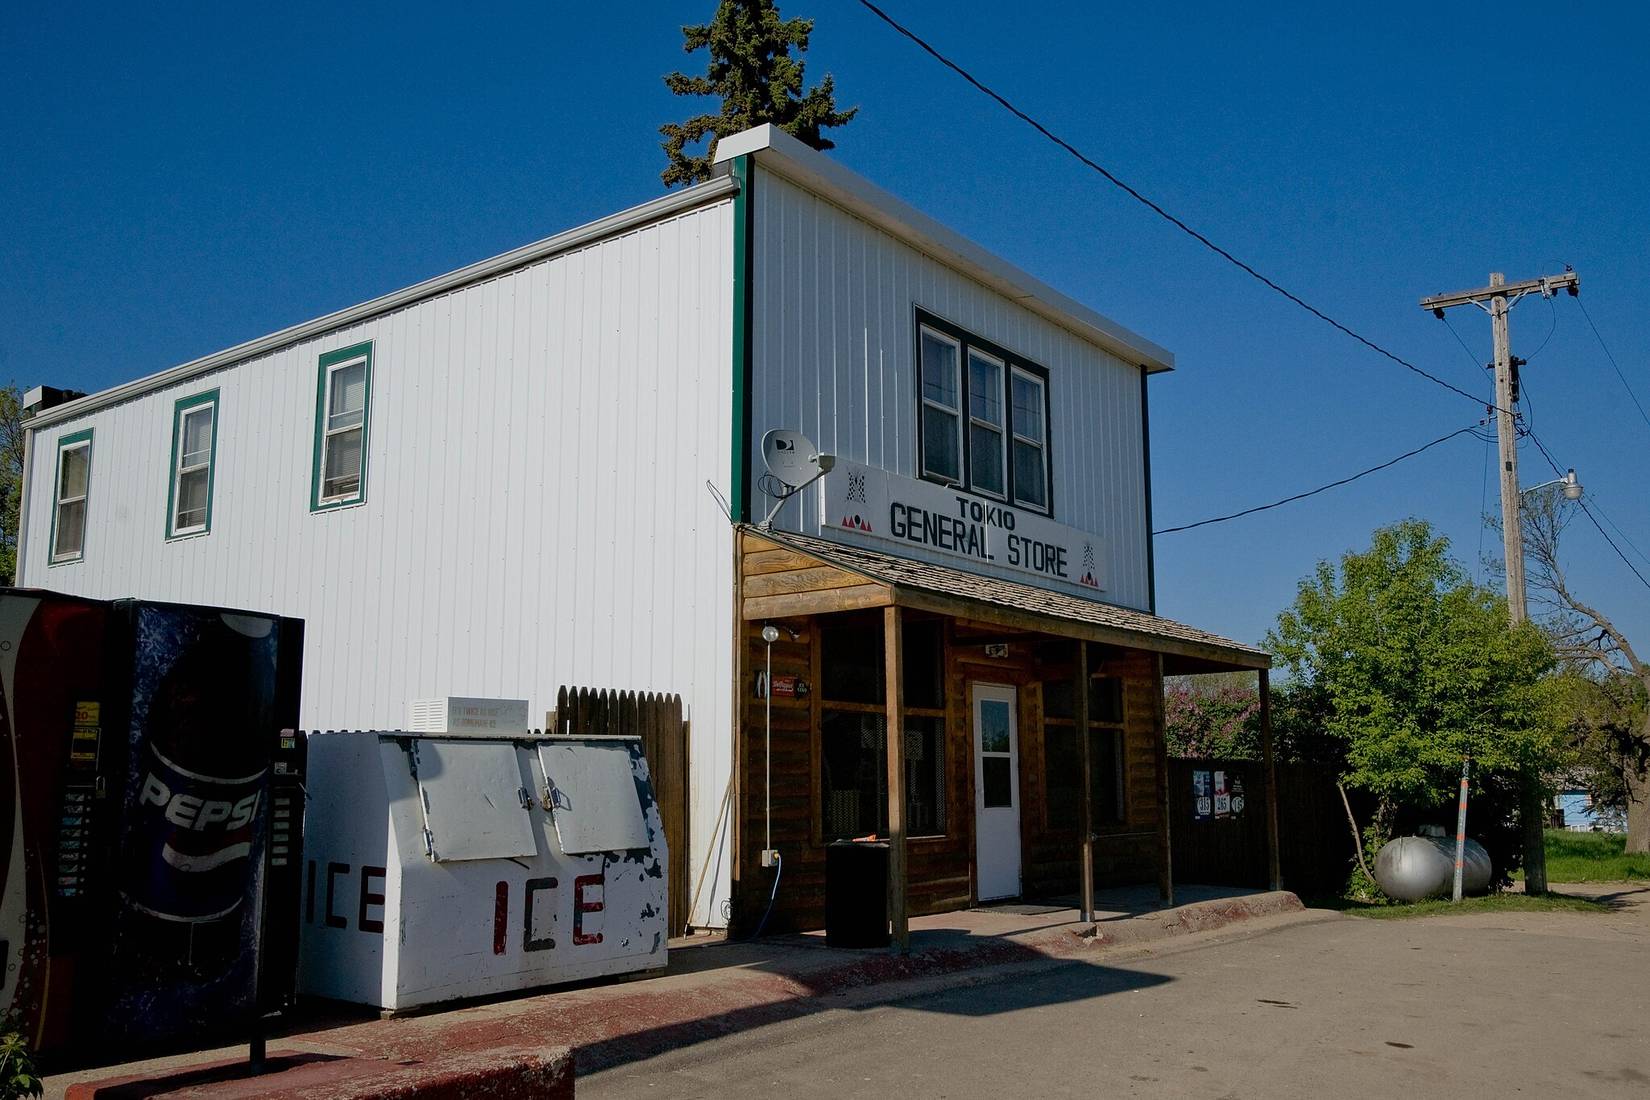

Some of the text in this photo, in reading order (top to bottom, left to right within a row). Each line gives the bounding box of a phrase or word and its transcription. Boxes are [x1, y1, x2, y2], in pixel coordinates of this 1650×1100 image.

[890, 502, 1068, 578] GENERAL STORE
[956, 496, 1015, 531] TOKIO
[139, 771, 262, 831] PEPSI
[306, 860, 386, 933] ICE
[493, 874, 604, 955] ICE
